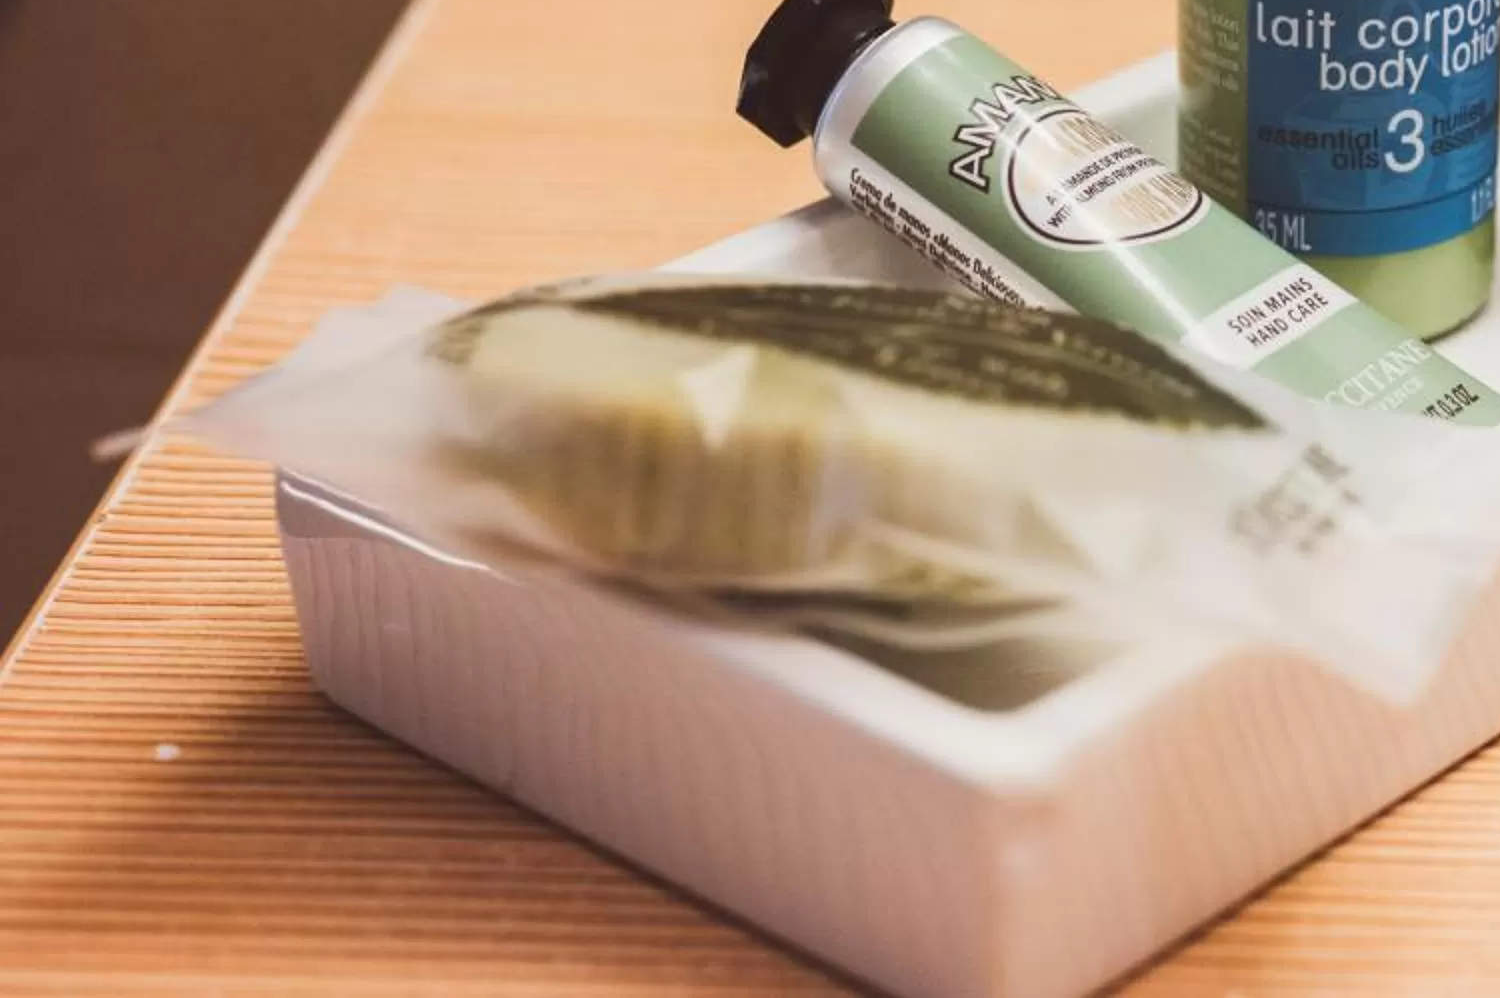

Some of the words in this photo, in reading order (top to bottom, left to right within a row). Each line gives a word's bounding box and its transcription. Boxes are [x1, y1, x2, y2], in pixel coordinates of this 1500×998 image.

[1256, 1, 1337, 51] lait
[1319, 48, 1430, 96] body
[1257, 124, 1382, 152] essential
[1383, 108, 1426, 173] 3
[1282, 213, 1313, 251] ML
[1227, 305, 1268, 334] SOIN
[1263, 277, 1314, 313] MAINS
[1245, 316, 1289, 347] HAND
[1287, 291, 1329, 323] CARE
